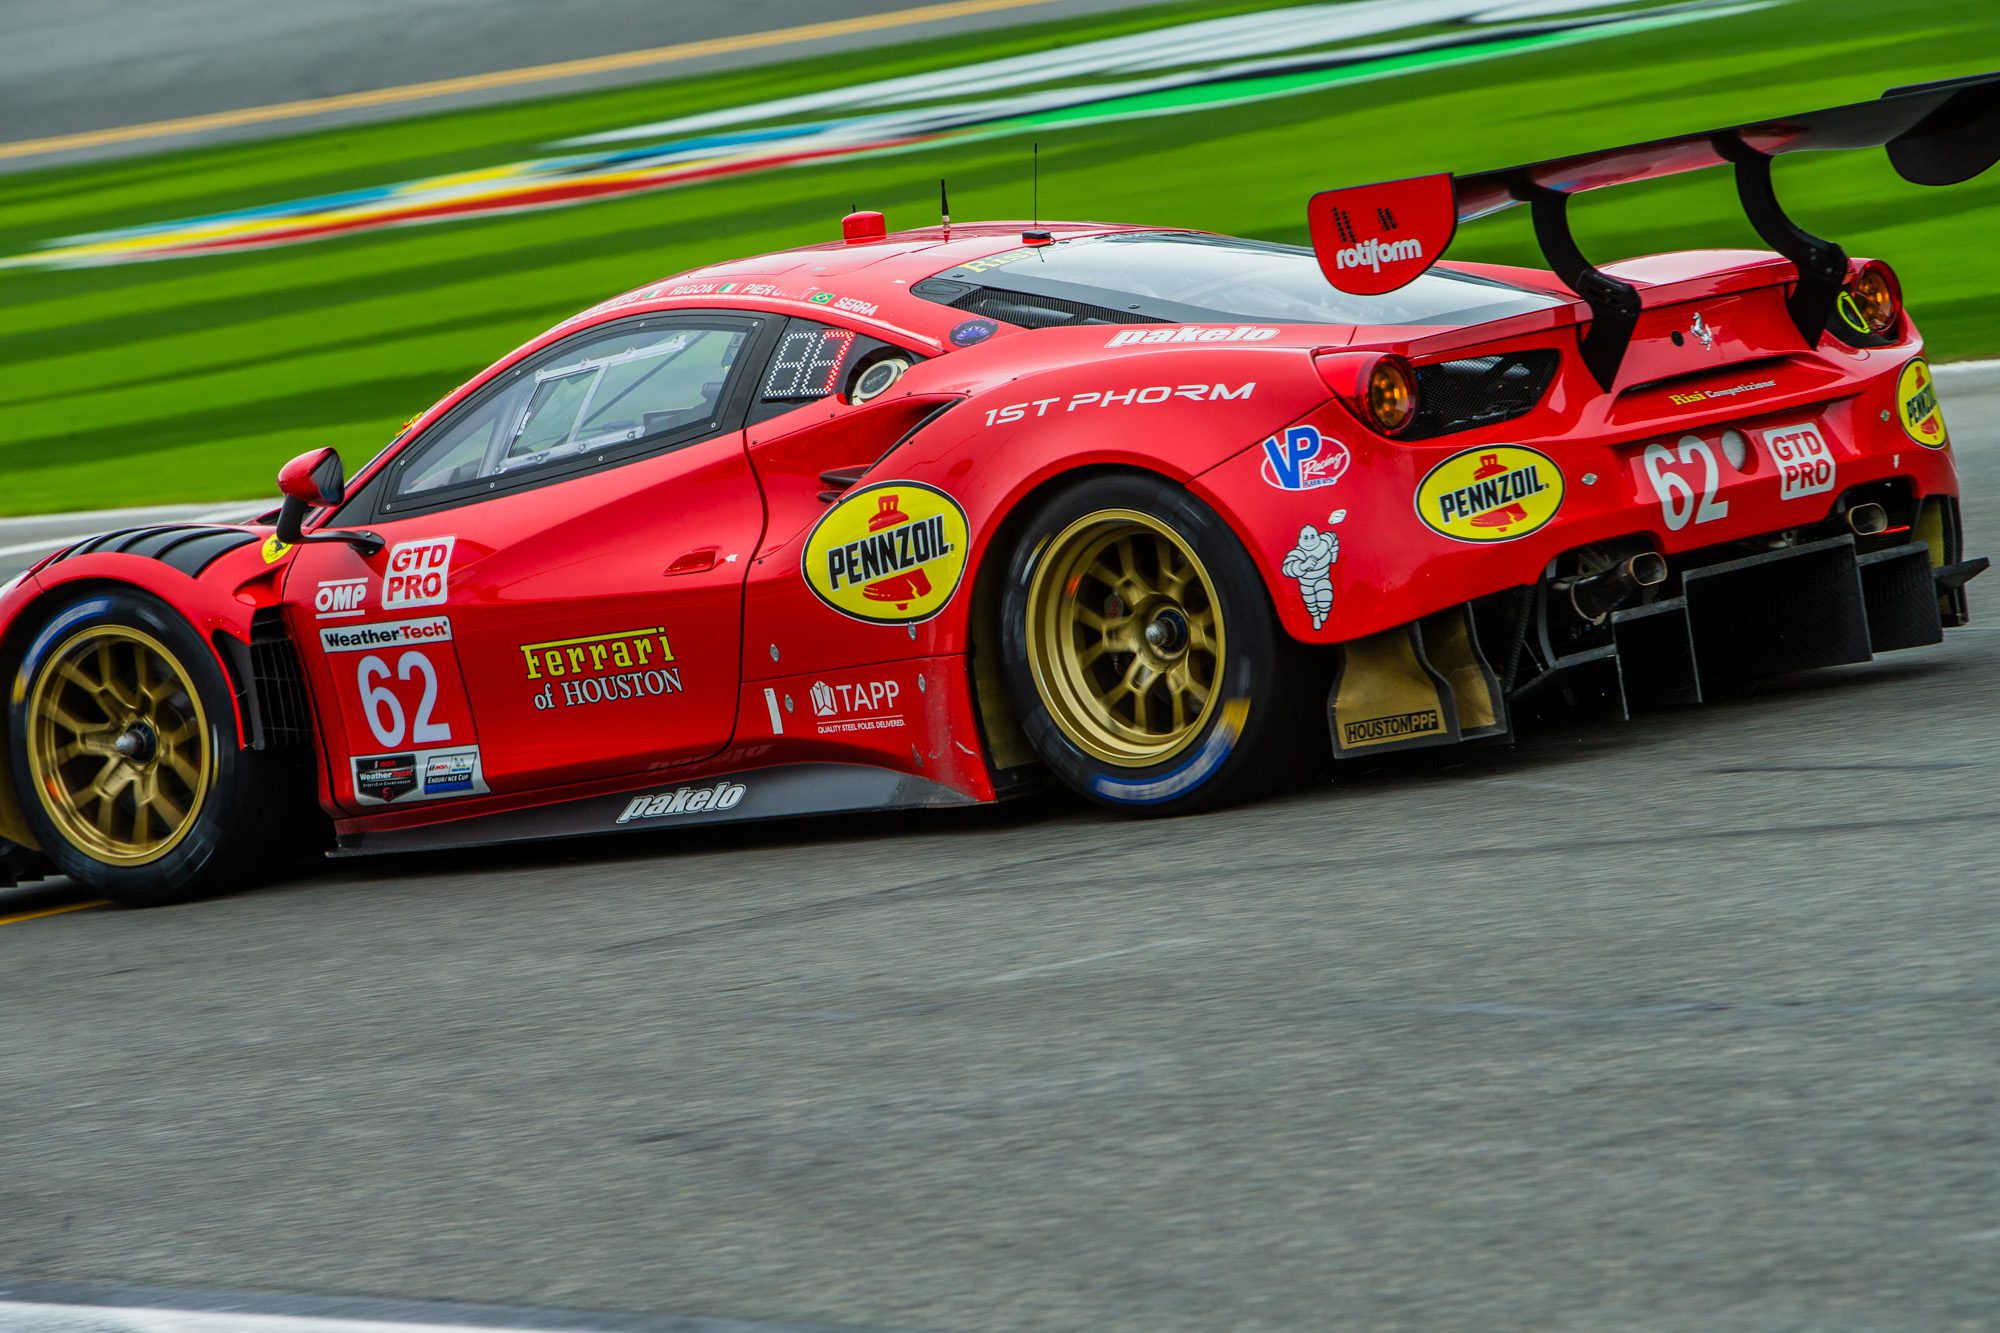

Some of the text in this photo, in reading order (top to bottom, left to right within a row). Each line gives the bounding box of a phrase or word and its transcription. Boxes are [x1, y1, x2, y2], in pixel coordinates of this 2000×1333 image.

[1336, 238, 1422, 273] rotiform
[669, 283, 717, 296] RIGON
[833, 297, 879, 316] SERRA
[1105, 326, 1280, 348] pakelo
[985, 382, 1256, 427] 1ST PHORM
[1668, 380, 1776, 405] Risi Competizione
[1262, 425, 1321, 490] VP
[1772, 431, 1822, 461] GTD
[1303, 452, 1346, 480] Racing
[1783, 459, 1830, 492] PRO
[1303, 478, 1334, 487] FUELS
[1438, 464, 1545, 524] PENNZOIL
[1644, 435, 1729, 531] 62
[391, 544, 447, 572] GTD
[827, 514, 950, 592] PENNZOIL
[315, 584, 366, 612] OMP
[387, 572, 441, 602] PRO
[325, 622, 447, 647] WeatherTech
[520, 627, 675, 680] Ferrari
[357, 650, 451, 748] 62
[534, 668, 683, 710] of HOUSTON
[835, 680, 900, 712] TAPP
[818, 723, 841, 734] QUALITY
[842, 722, 857, 732] STEEL
[1348, 711, 1437, 741] HOUSTON PPF
[616, 781, 747, 824] pakelo
